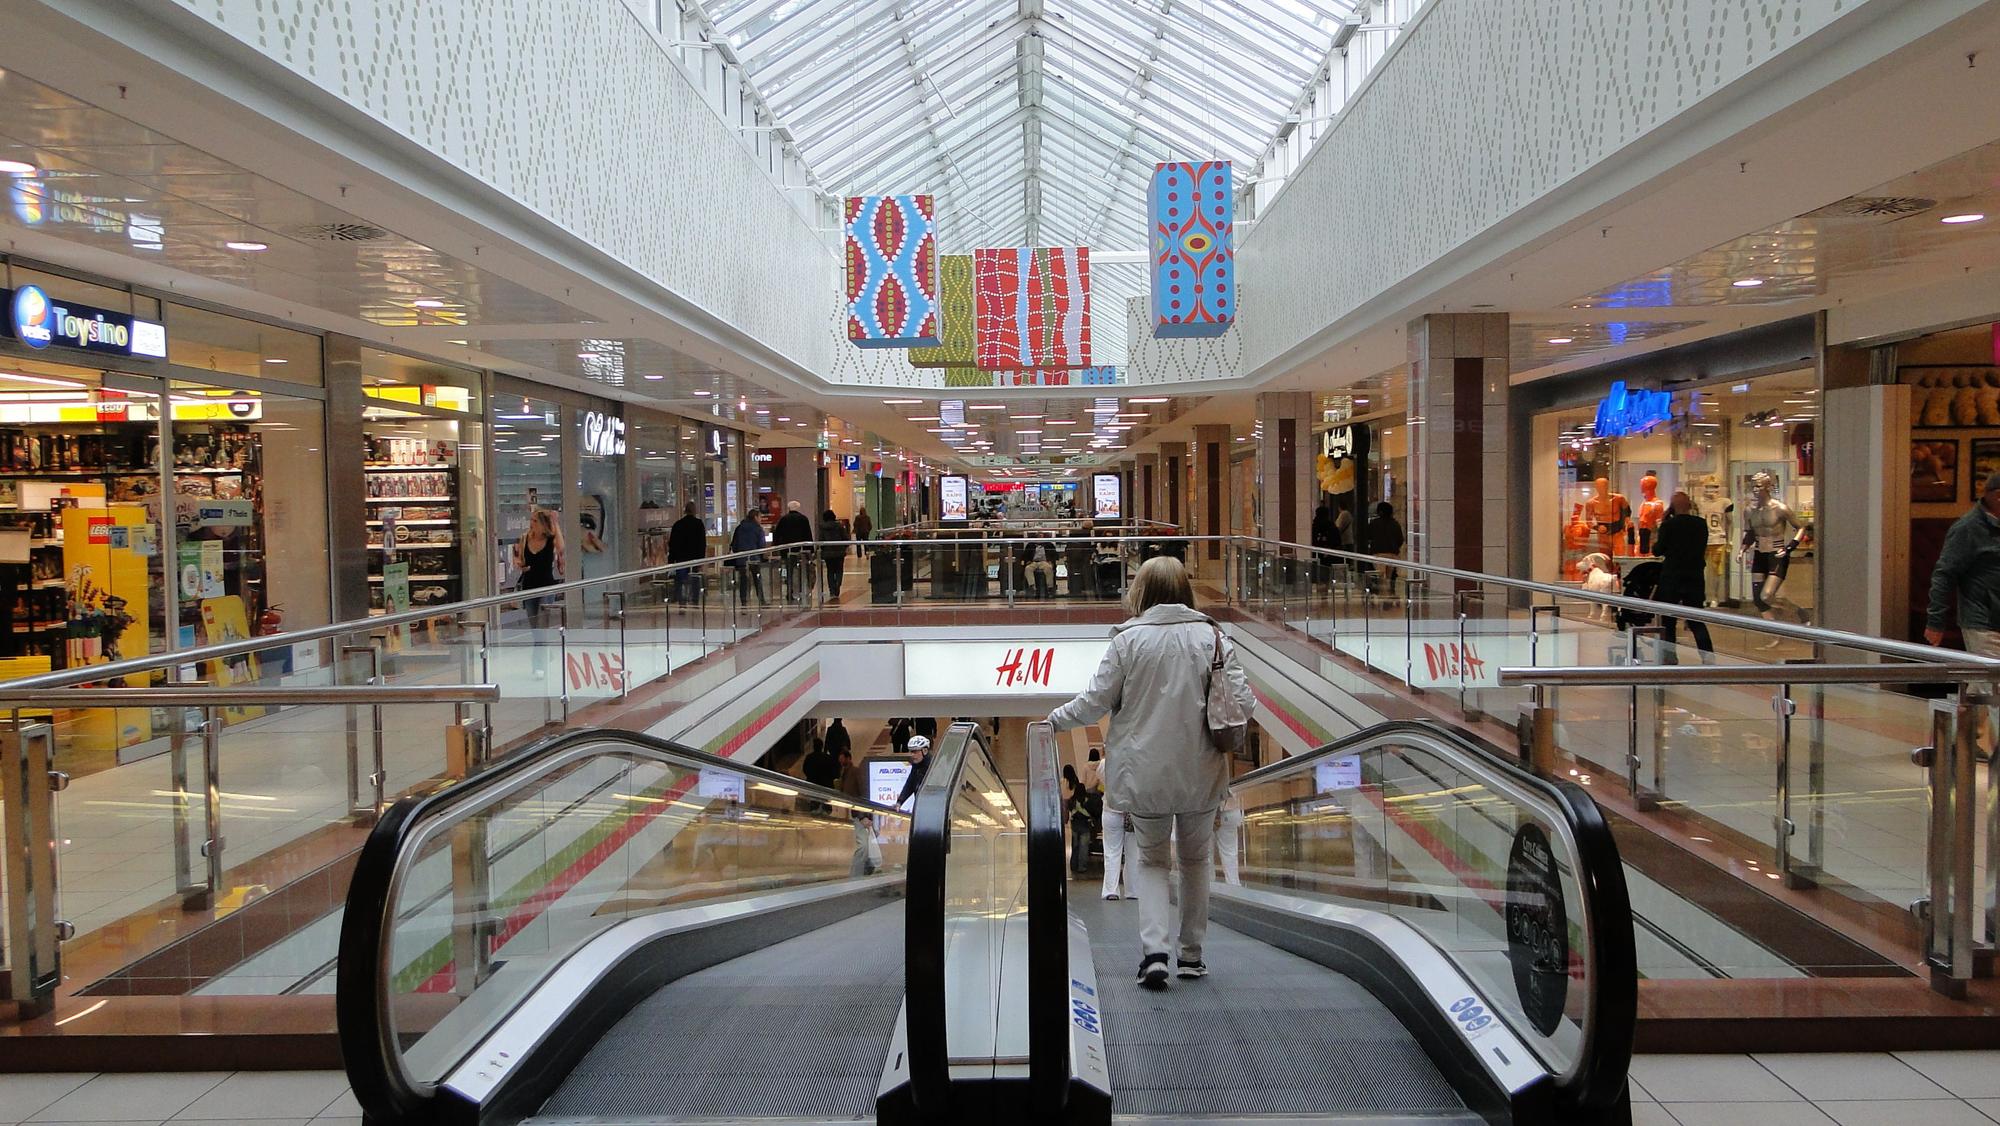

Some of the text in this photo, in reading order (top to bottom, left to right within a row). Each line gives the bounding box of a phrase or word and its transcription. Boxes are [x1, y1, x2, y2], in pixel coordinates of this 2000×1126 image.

[53, 306, 129, 347] Toysino
[847, 456, 857, 467] P
[996, 648, 1055, 687] H&M
